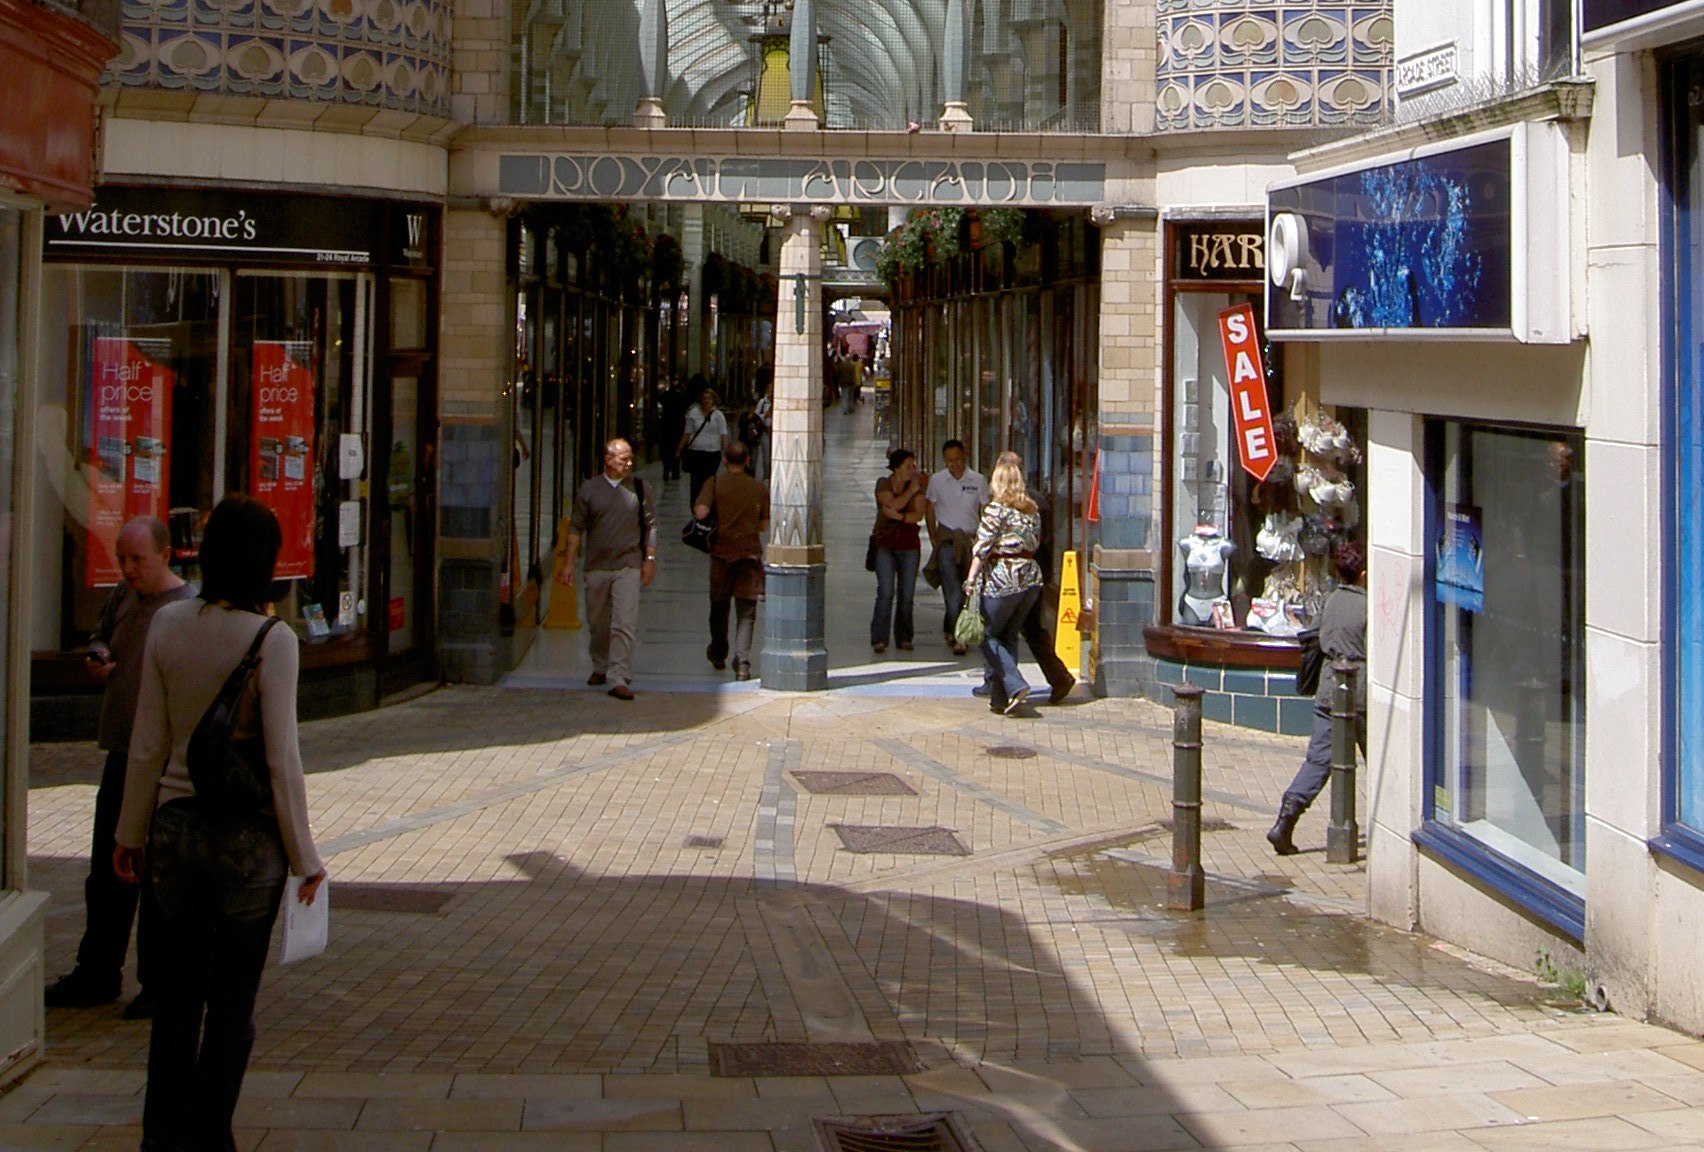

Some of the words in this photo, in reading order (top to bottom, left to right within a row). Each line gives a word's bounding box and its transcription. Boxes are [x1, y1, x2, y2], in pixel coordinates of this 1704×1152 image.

[1427, 50, 1455, 78] STREET
[546, 155, 747, 200] ROYAL
[801, 159, 1058, 203] ARCADE
[58, 203, 257, 240] Waterstone's
[406, 214, 422, 246] W
[1189, 233, 1265, 276] HAR
[1270, 213, 1309, 301] O2
[102, 360, 143, 381] Half
[1226, 313, 1270, 460] SALE
[101, 381, 153, 406] price
[260, 384, 298, 408] price
